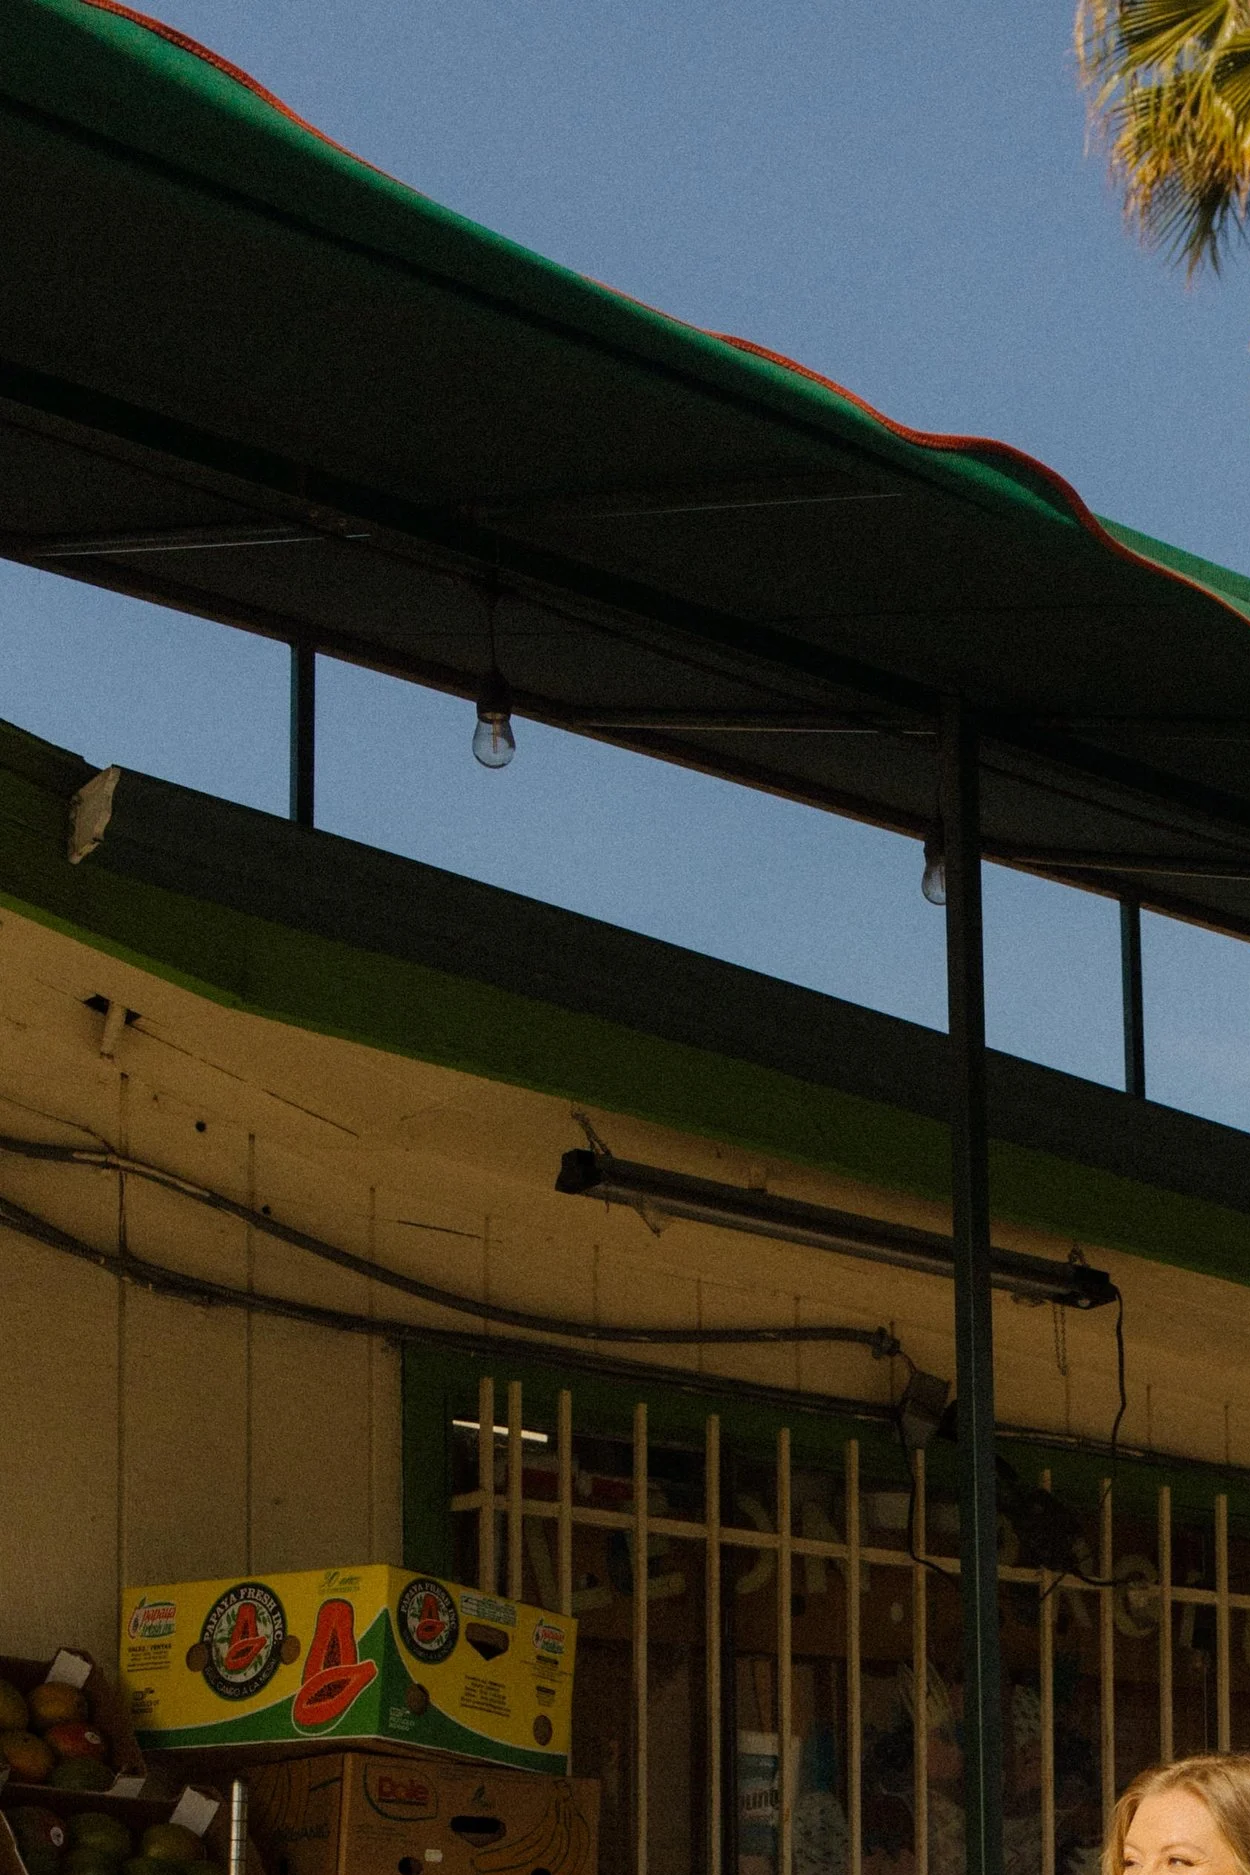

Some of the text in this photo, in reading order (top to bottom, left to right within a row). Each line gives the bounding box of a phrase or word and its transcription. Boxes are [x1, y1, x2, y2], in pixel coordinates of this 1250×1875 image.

[400, 1585, 424, 1613] PAPAYA
[424, 1583, 451, 1607] FRESH
[203, 1593, 238, 1643] PAPAYA
[239, 1587, 277, 1612] FRESH
[379, 1776, 430, 1801] Dole
